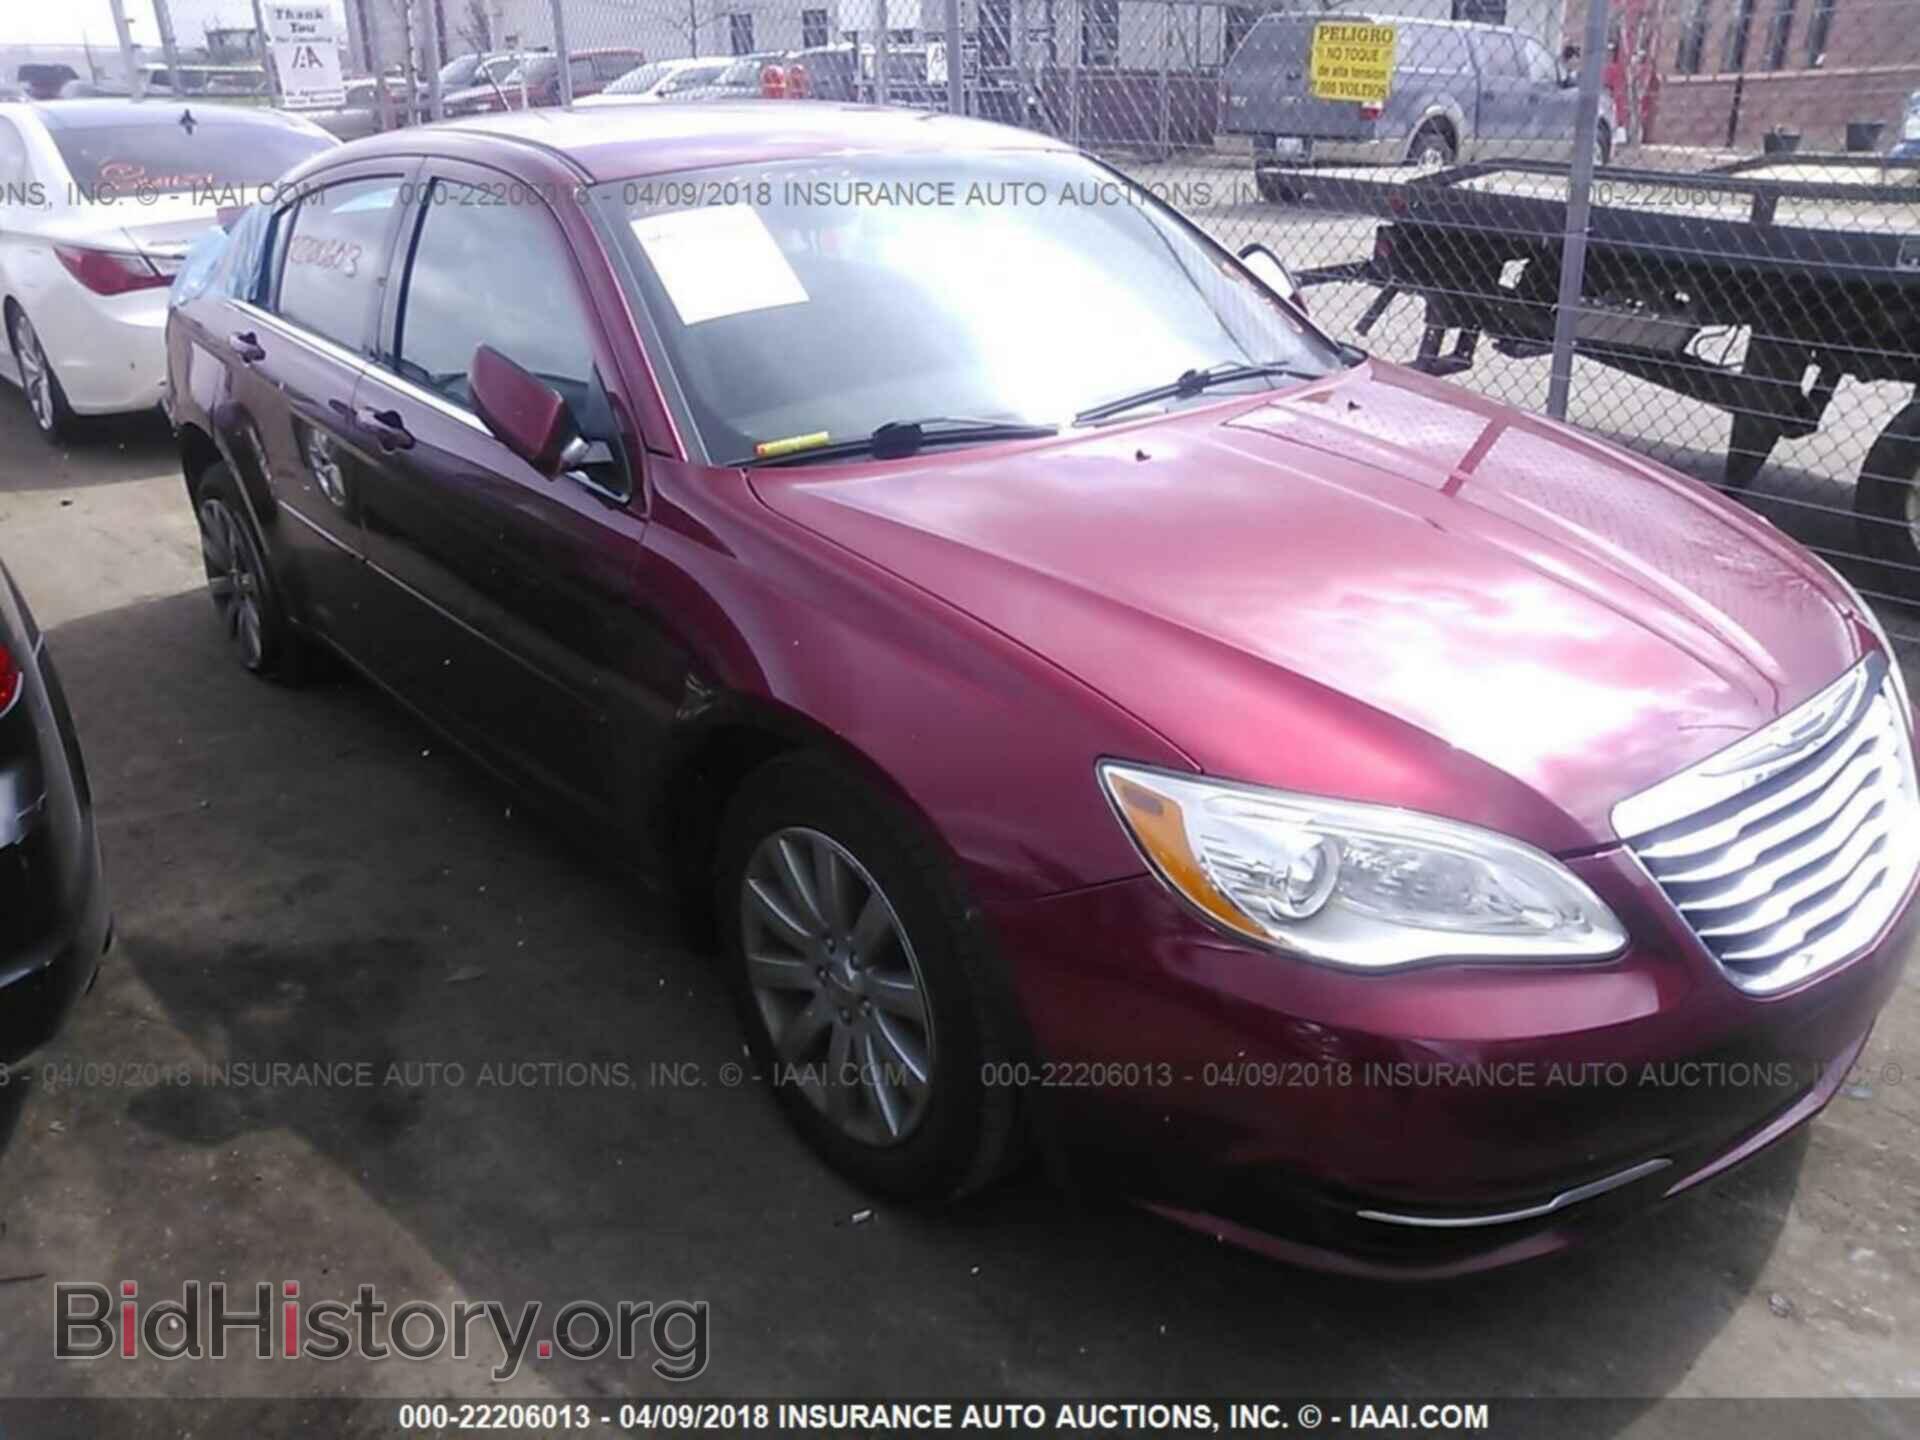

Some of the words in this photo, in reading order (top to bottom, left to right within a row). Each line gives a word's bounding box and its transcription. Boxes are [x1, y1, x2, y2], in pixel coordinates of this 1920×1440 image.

[275, 7, 324, 20] Thank
[289, 21, 316, 34] You
[1319, 25, 1394, 44] PELIGRO
[1326, 47, 1342, 61] NO
[1345, 47, 1379, 63] TOQUE
[1339, 80, 1387, 98] VOLTIOS
